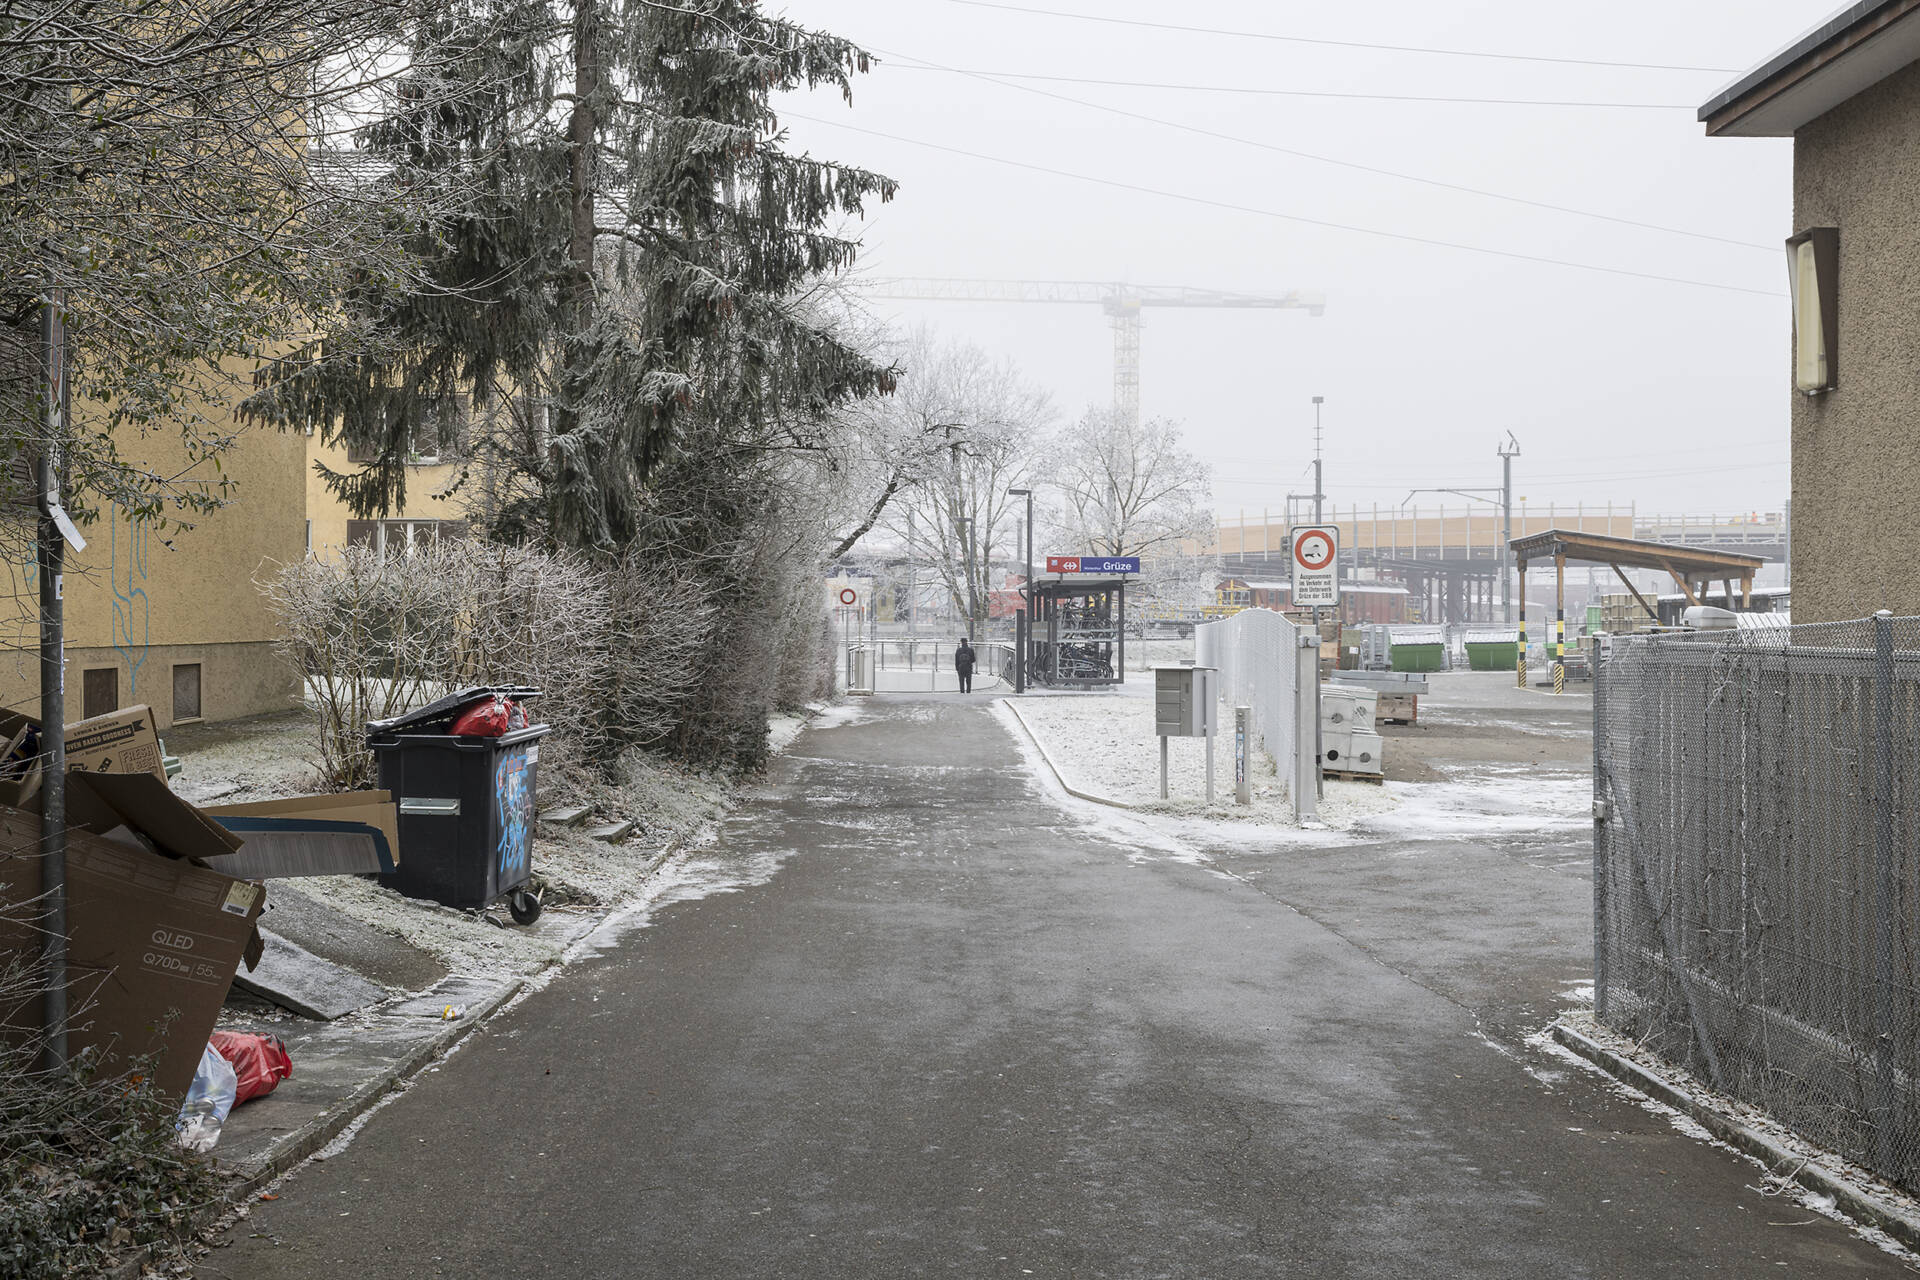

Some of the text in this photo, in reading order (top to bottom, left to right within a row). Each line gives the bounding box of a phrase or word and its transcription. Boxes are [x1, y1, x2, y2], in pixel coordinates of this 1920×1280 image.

[1103, 561, 1132, 570] Grüze
[65, 741, 81, 751] OVEN
[83, 736, 102, 747] BAKED
[102, 727, 132, 741] GOODNESS
[151, 929, 194, 950] QLED
[143, 952, 181, 971] Q70D
[196, 963, 214, 978] 55
